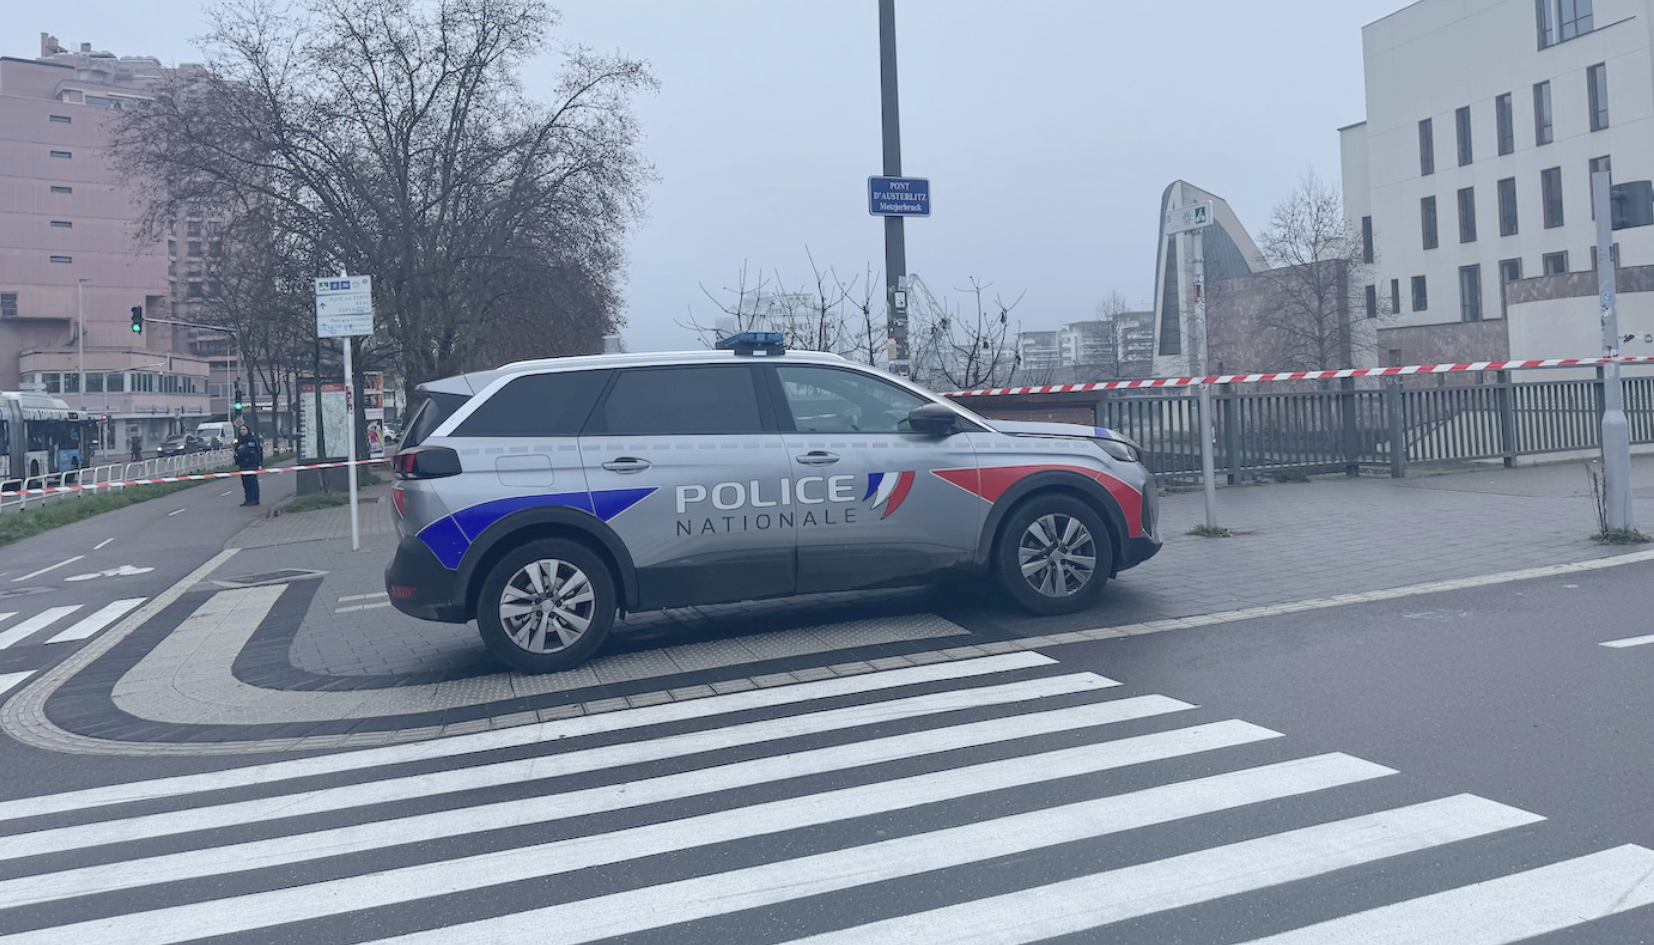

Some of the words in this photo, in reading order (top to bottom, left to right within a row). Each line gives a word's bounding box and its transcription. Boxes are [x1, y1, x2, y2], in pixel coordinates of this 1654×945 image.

[889, 182, 910, 190] PONT
[873, 191, 927, 201] D'AUSTERLITZ
[675, 474, 856, 514] POLICE
[676, 507, 857, 536] NATIONALE
